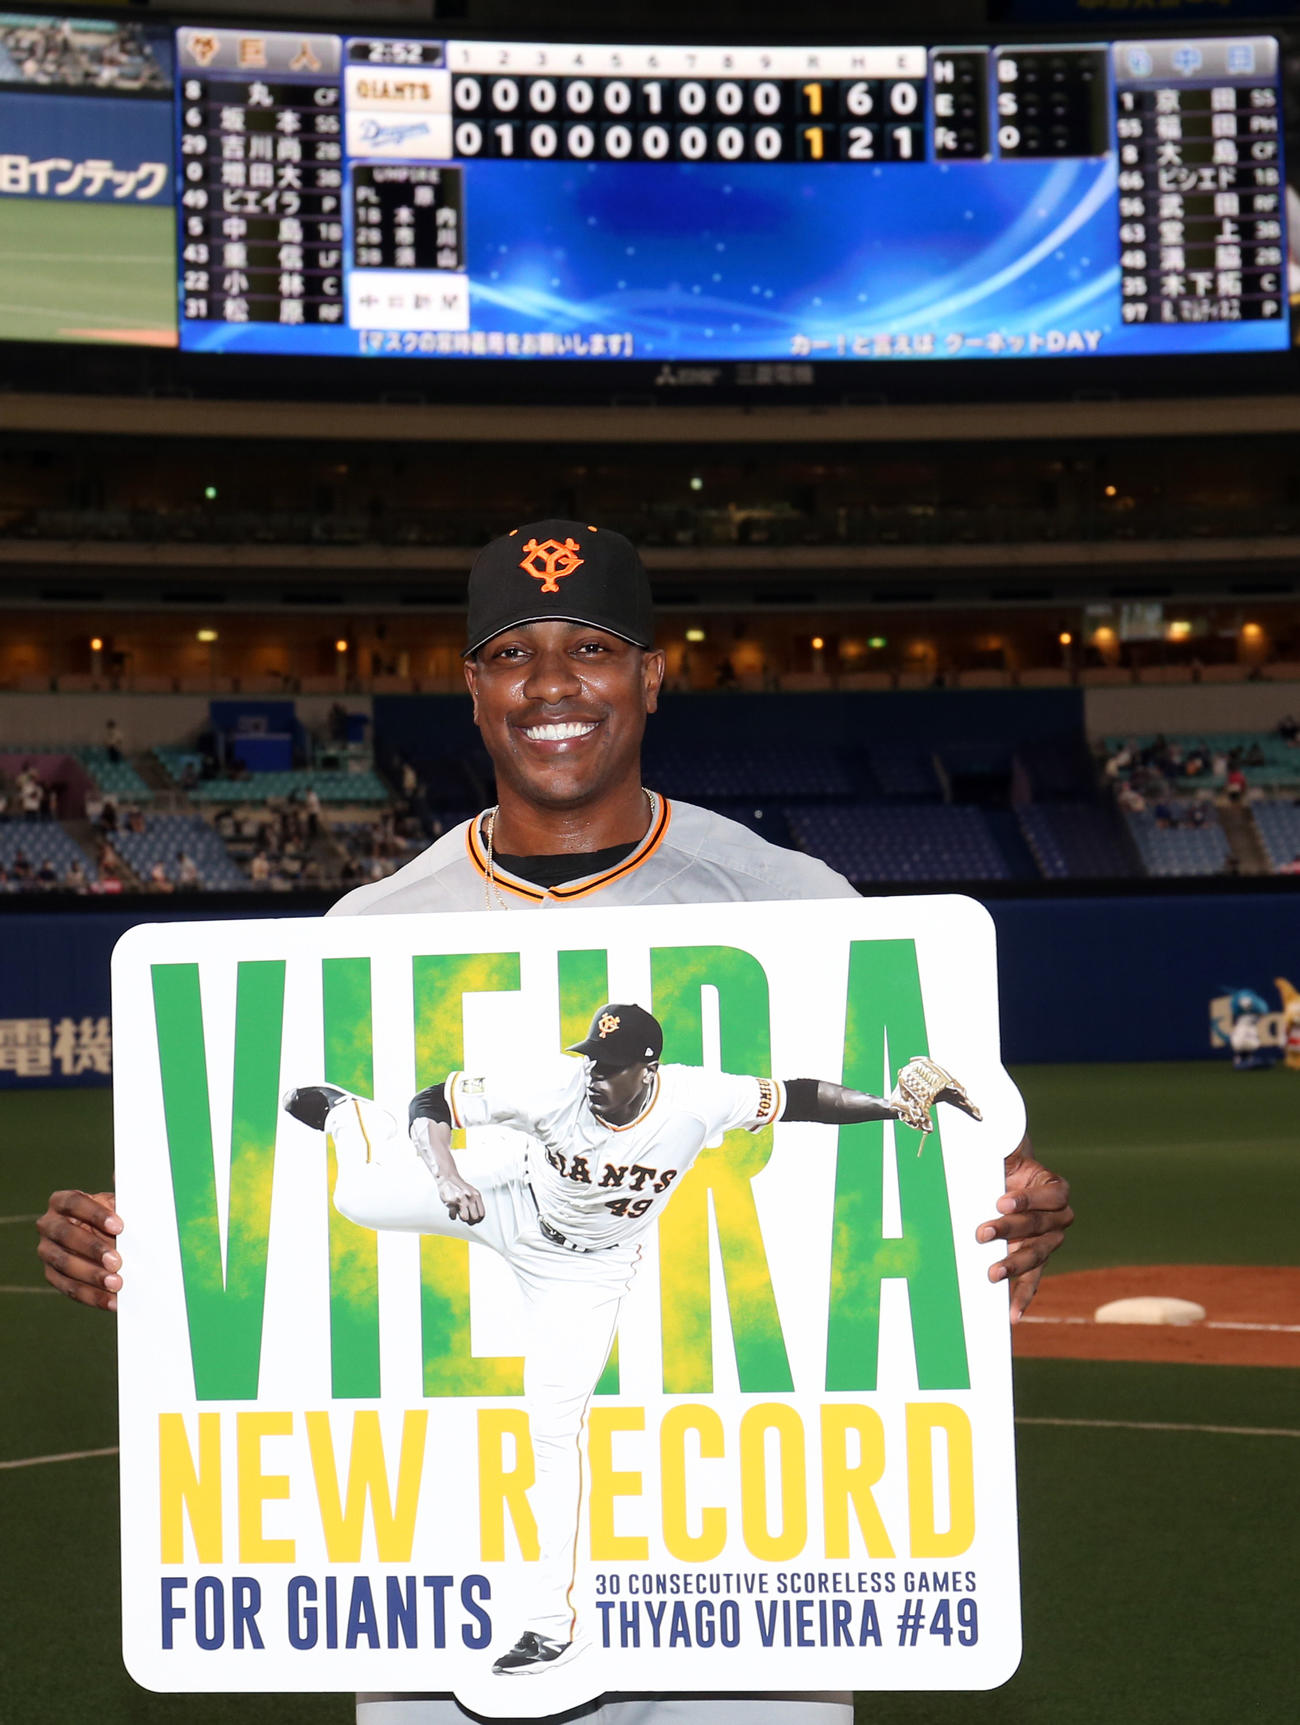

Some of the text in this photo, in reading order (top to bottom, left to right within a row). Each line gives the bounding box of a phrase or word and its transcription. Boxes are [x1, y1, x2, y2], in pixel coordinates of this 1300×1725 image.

[455, 78, 481, 111] 0
[492, 79, 519, 112] 0
[529, 80, 556, 112] 0
[567, 80, 593, 113] 0
[604, 81, 631, 114] 0
[643, 82, 661, 114] 1
[679, 82, 706, 115] 0
[716, 82, 743, 115] 0
[754, 82, 780, 115] 0
[804, 83, 822, 115] 1
[847, 82, 873, 115] 6
[891, 82, 917, 115] 0
[456, 122, 482, 155] 0
[495, 123, 513, 156] 1
[531, 124, 556, 157] 0
[568, 125, 594, 157] 0
[606, 126, 631, 158] 0
[643, 126, 669, 158] 0
[680, 126, 706, 159] 0
[718, 127, 743, 159] 0
[755, 127, 781, 159] 0
[805, 127, 823, 159] 1
[849, 127, 873, 159] 2
[894, 127, 912, 158] 1
[150, 938, 971, 1401] VIERA
[604, 1198, 654, 1218] 49
[158, 1402, 977, 1565] NEW RECORD
[596, 1571, 977, 1595] 30 CONSECUTIVE SCORELESS GAMES
[161, 1574, 493, 1651] FOR GIANTS
[596, 1597, 979, 1648] THYAGO VIEIRA #49
